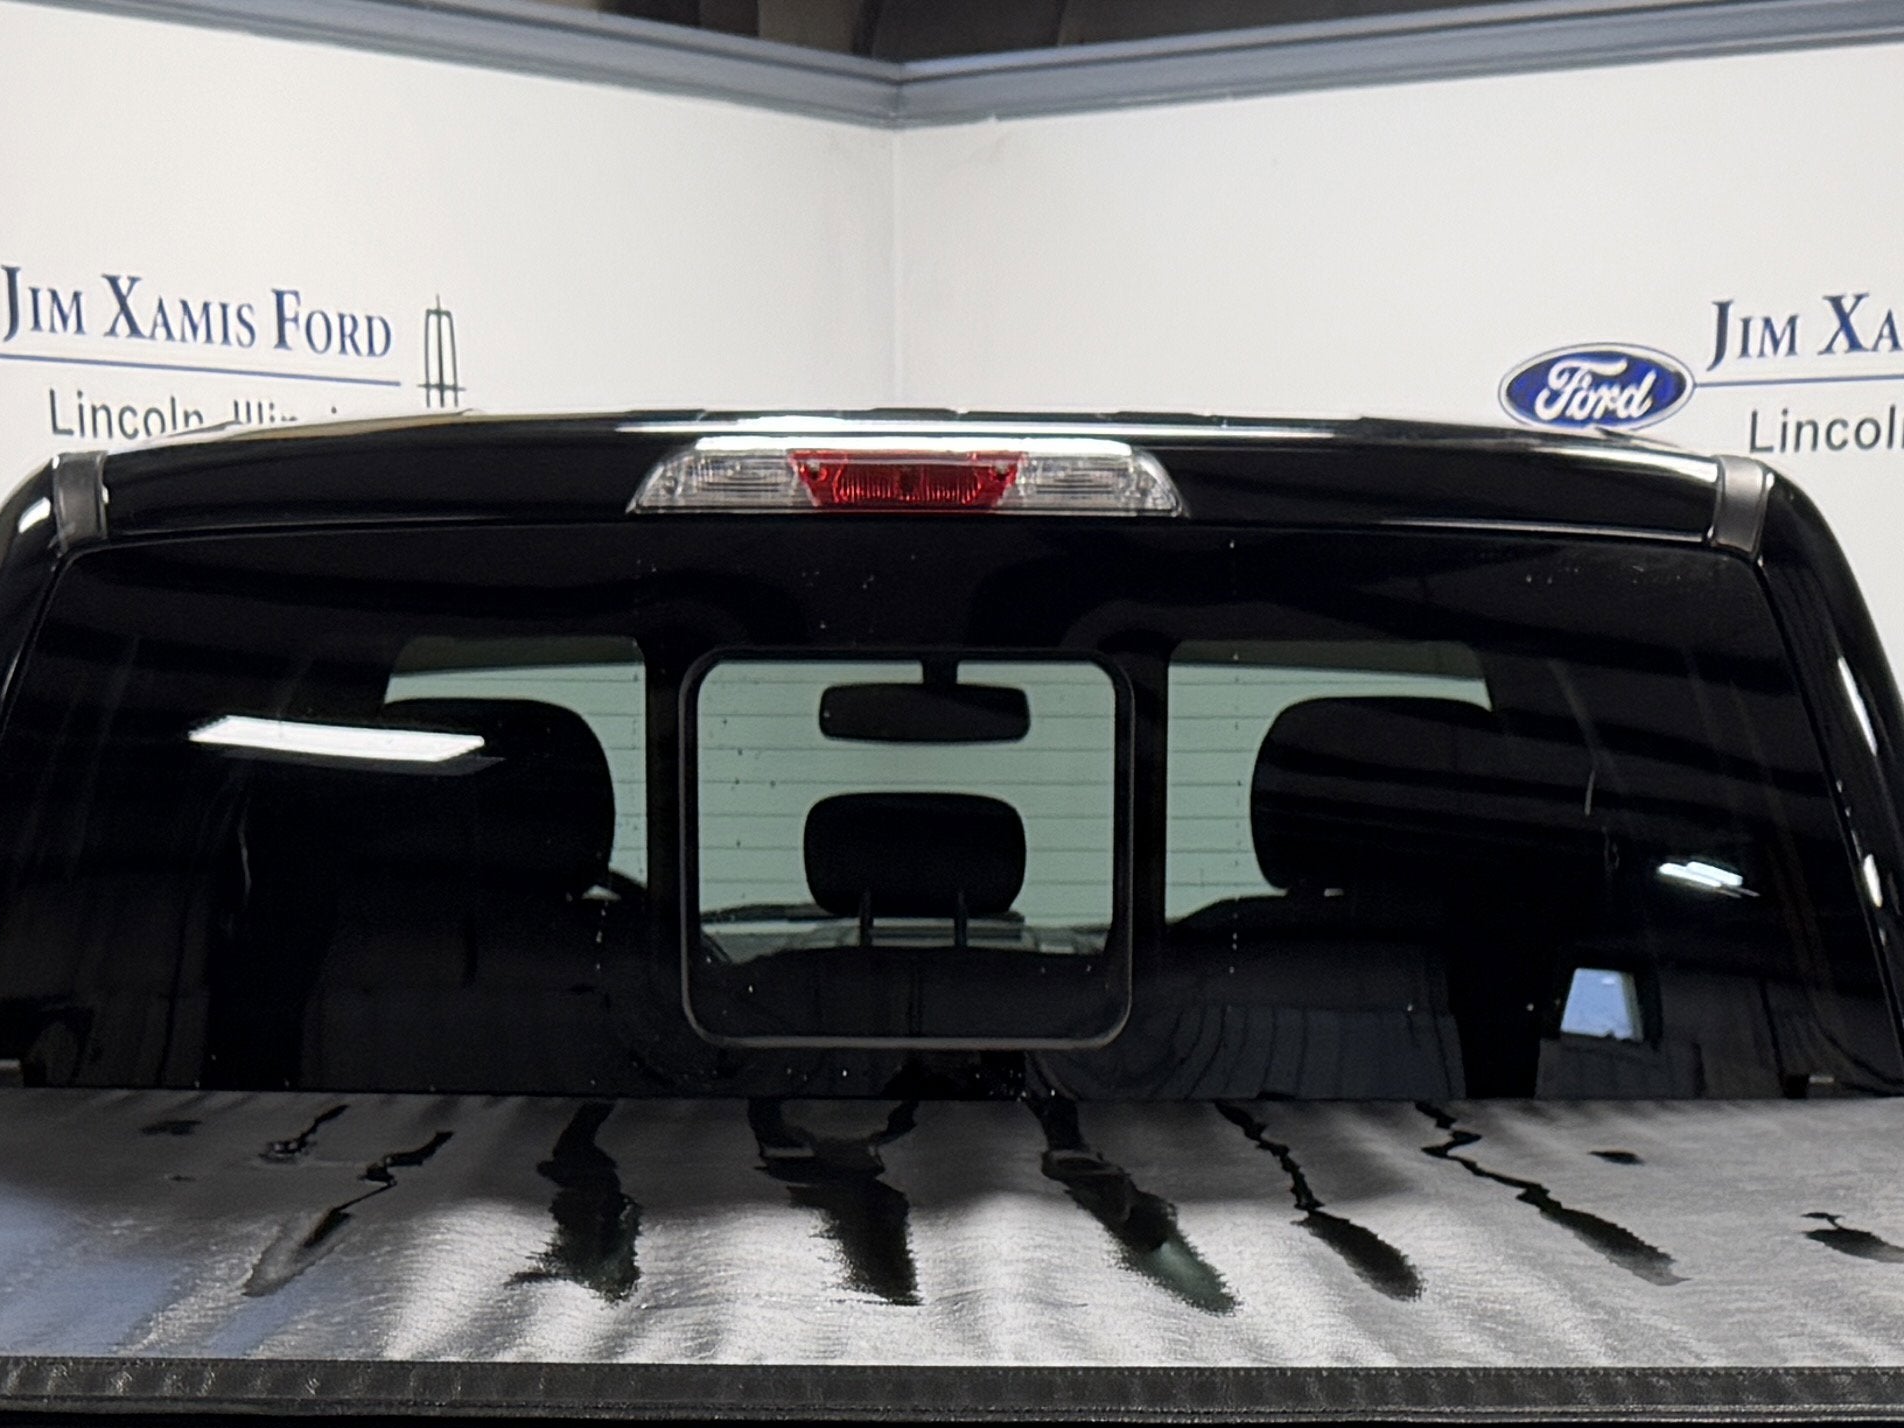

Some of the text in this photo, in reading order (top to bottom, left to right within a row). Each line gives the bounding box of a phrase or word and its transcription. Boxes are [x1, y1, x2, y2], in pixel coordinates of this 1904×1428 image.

[0, 265, 392, 357] JIM XAMIS FORD
[1706, 299, 1800, 372] JIM
[1534, 357, 1654, 421] Ford
